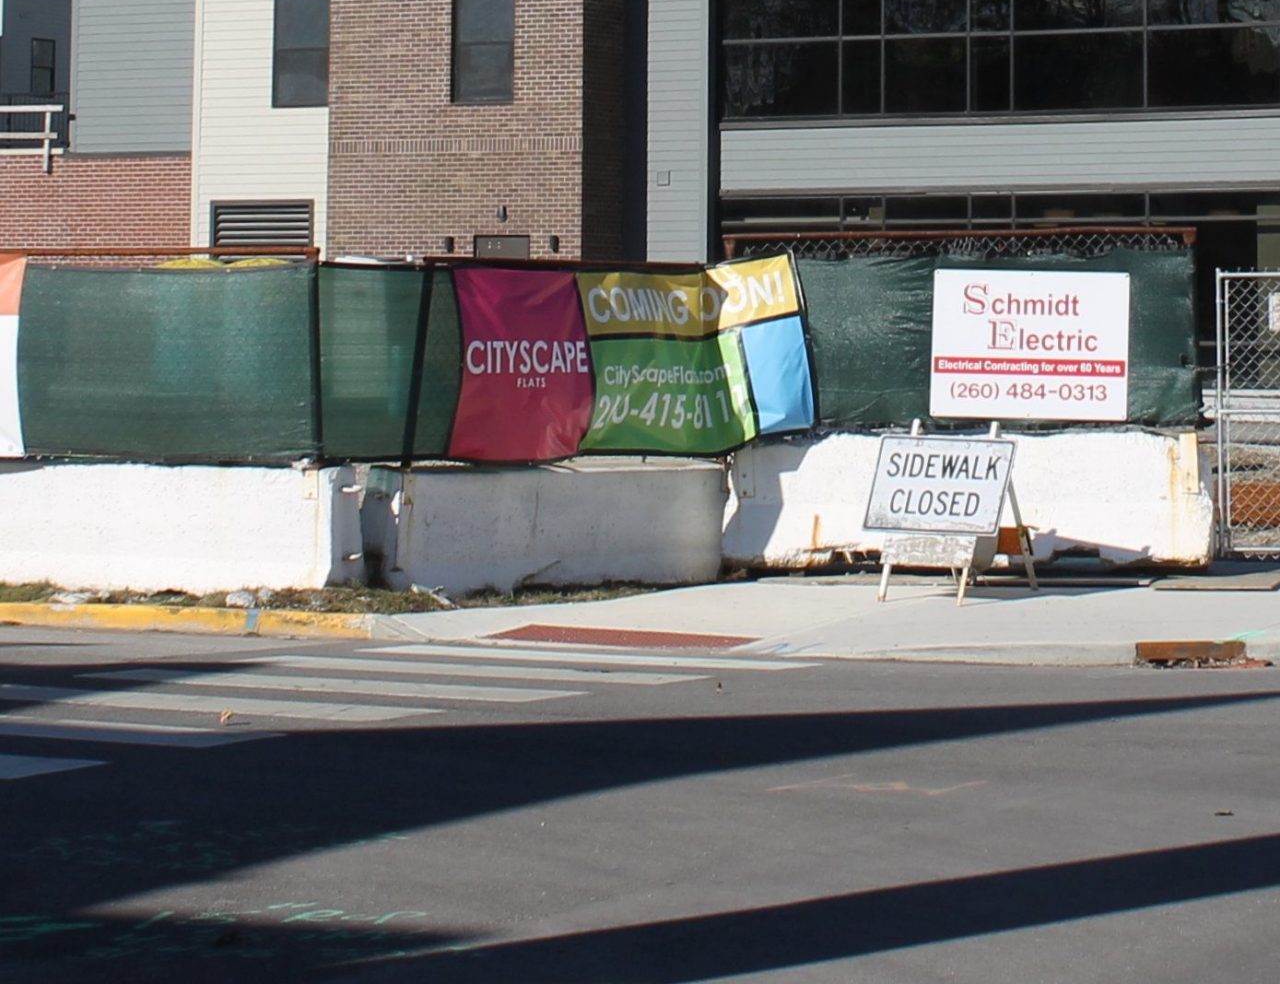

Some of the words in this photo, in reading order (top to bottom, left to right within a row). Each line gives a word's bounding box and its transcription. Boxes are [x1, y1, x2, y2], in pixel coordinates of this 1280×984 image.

[588, 286, 689, 325] COMING
[699, 270, 786, 322] OON!
[963, 284, 1080, 316] Schmidt
[987, 319, 1099, 352] Electric
[466, 340, 589, 375] CITYSCAPE
[938, 359, 982, 370] Electrical
[984, 360, 1039, 373] Contracting
[1041, 362, 1055, 372] for
[1057, 364, 1077, 373] over
[1094, 363, 1121, 374] Years
[516, 377, 547, 389] FLATS
[604, 362, 732, 389] CityScapeFla.com
[950, 382, 999, 400] (260)
[1006, 383, 1108, 401] 484-0313
[886, 453, 1002, 480] SIDEWALK
[889, 489, 980, 517] CLOSED
